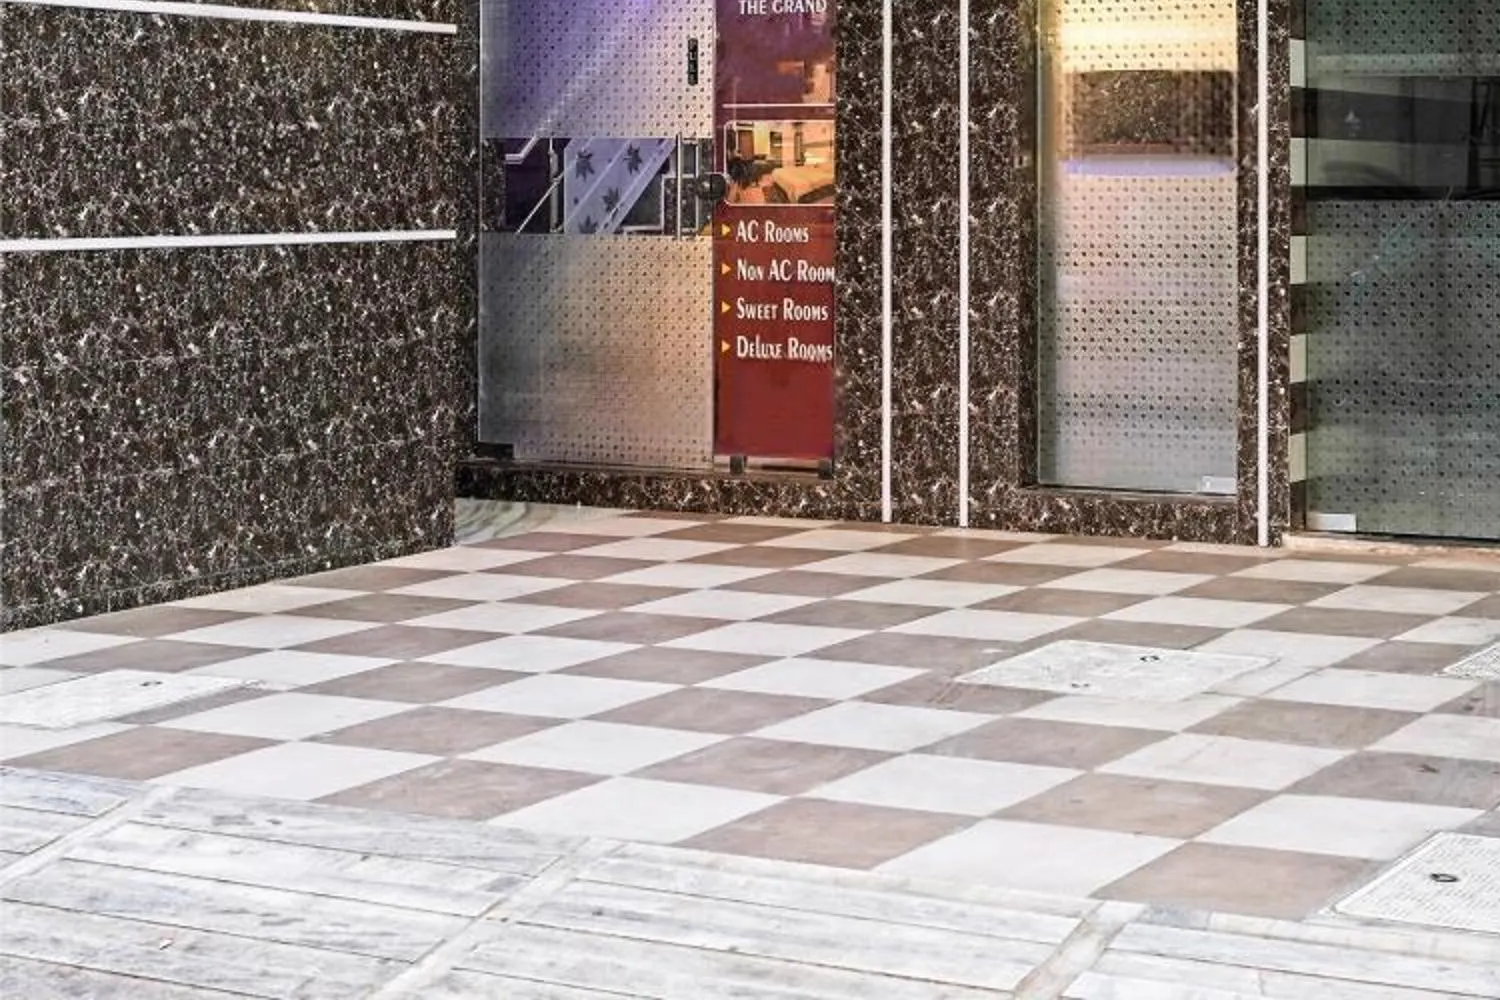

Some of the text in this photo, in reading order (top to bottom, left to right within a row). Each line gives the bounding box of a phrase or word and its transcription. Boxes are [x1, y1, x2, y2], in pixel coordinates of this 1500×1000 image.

[738, 0, 767, 15] THE
[736, 220, 759, 243] AC
[768, 259, 792, 281] AC
[797, 260, 836, 283] ROOM
